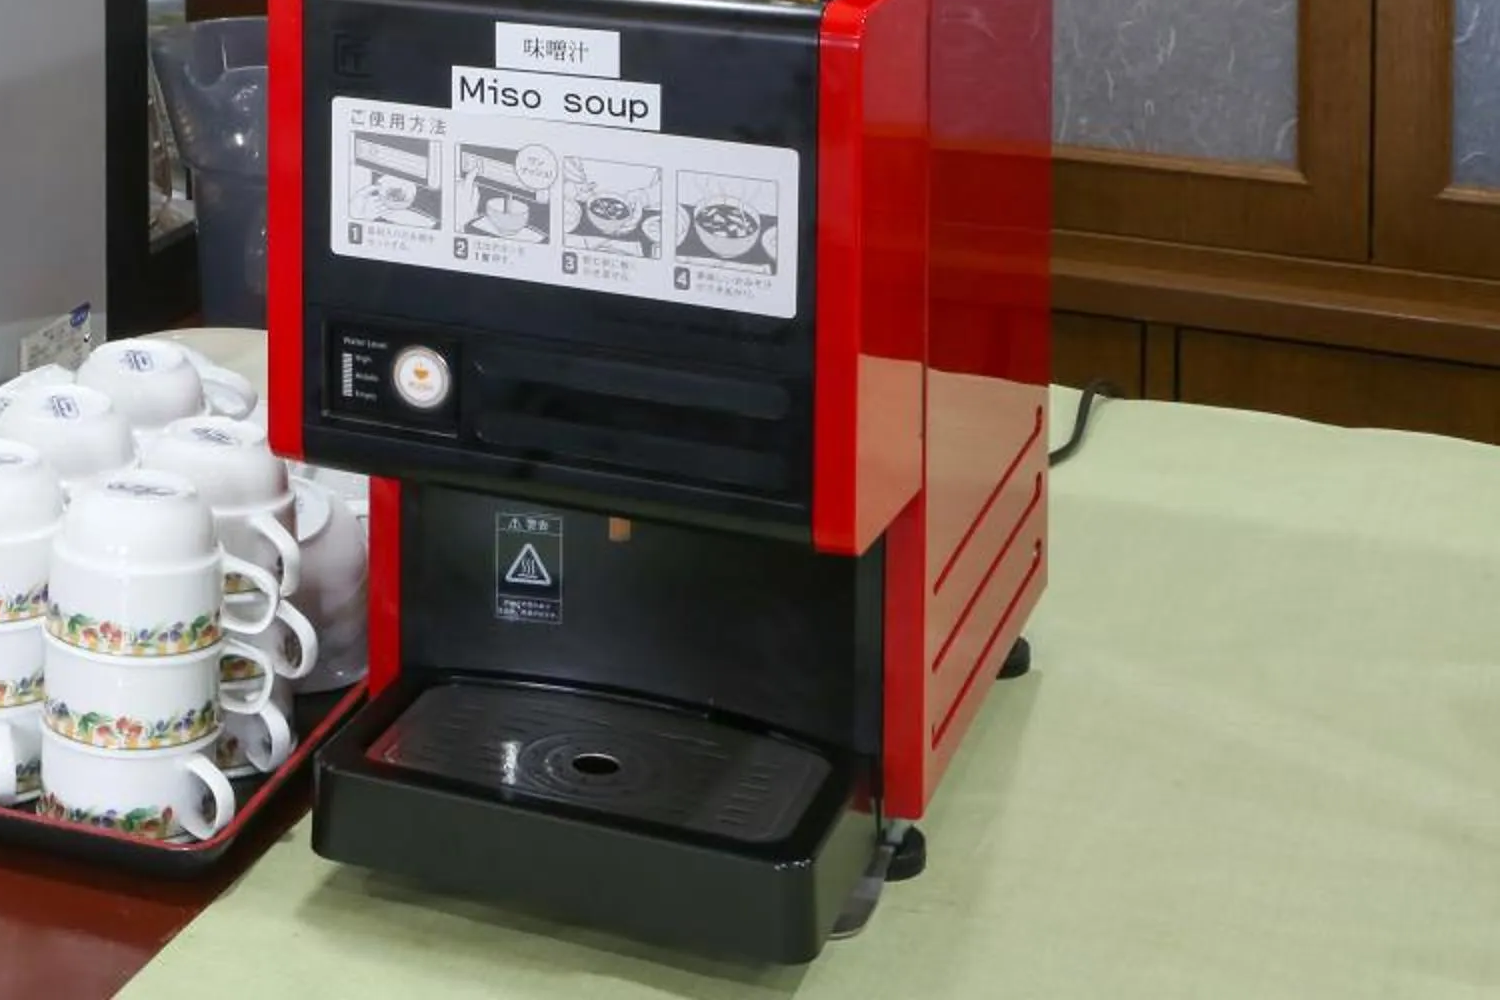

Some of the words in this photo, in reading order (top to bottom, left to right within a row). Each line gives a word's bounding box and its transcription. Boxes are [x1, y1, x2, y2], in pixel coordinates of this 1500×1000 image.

[523, 37, 590, 64] 味噌汁
[459, 75, 542, 109] Miso
[563, 91, 649, 123] soup
[350, 108, 447, 136] ご使用方法
